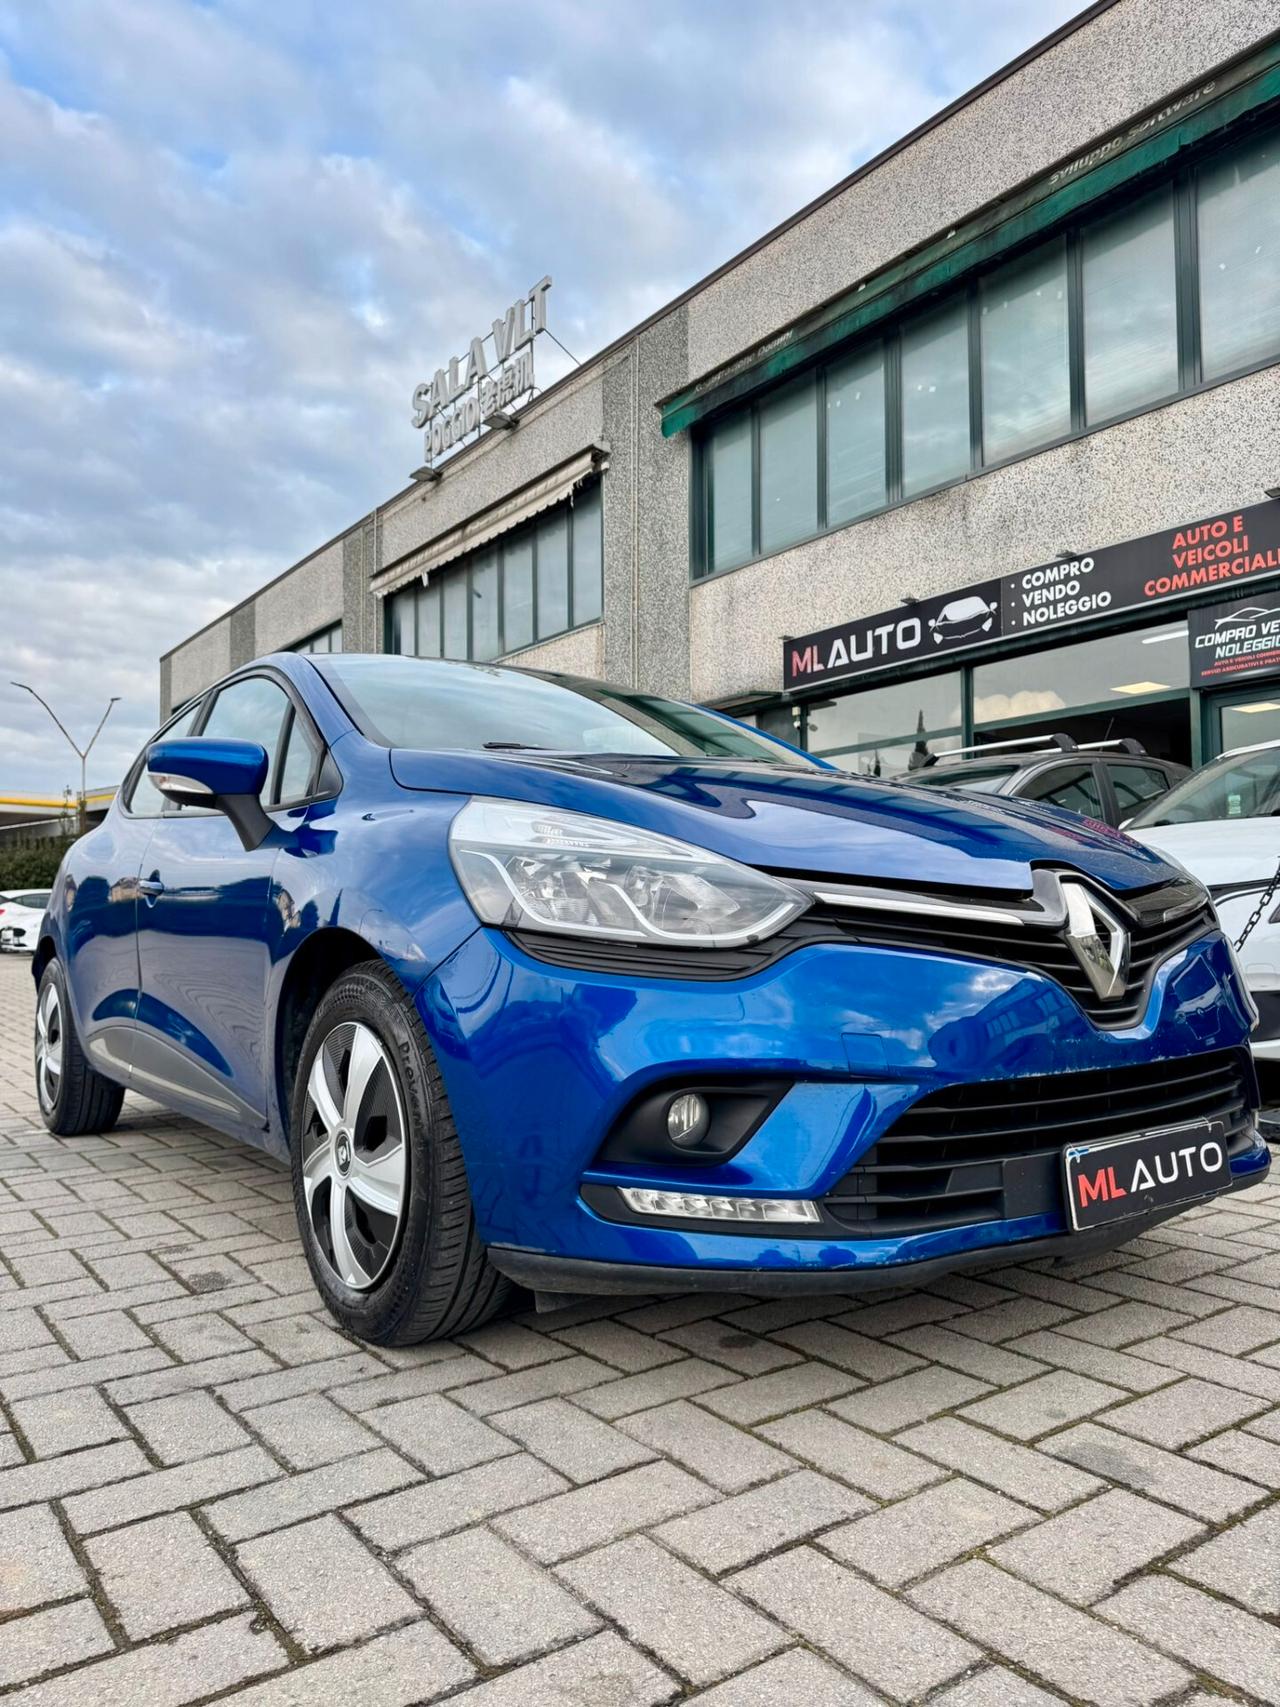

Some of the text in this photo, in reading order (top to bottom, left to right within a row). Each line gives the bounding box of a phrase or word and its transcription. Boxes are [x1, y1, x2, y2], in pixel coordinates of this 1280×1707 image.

[411, 275, 552, 429] SALA VLT
[1172, 515, 1244, 550] AUTO E
[1172, 535, 1249, 569] VEICOLI
[1022, 557, 1095, 589] COMPRO
[1022, 580, 1080, 608] VENDO
[1023, 591, 1112, 626] NOLEGGIO
[792, 617, 921, 677] ML AUTO
[1195, 620, 1280, 648] COMPRO VE
[1077, 1142, 1223, 1208] ML AUTO
